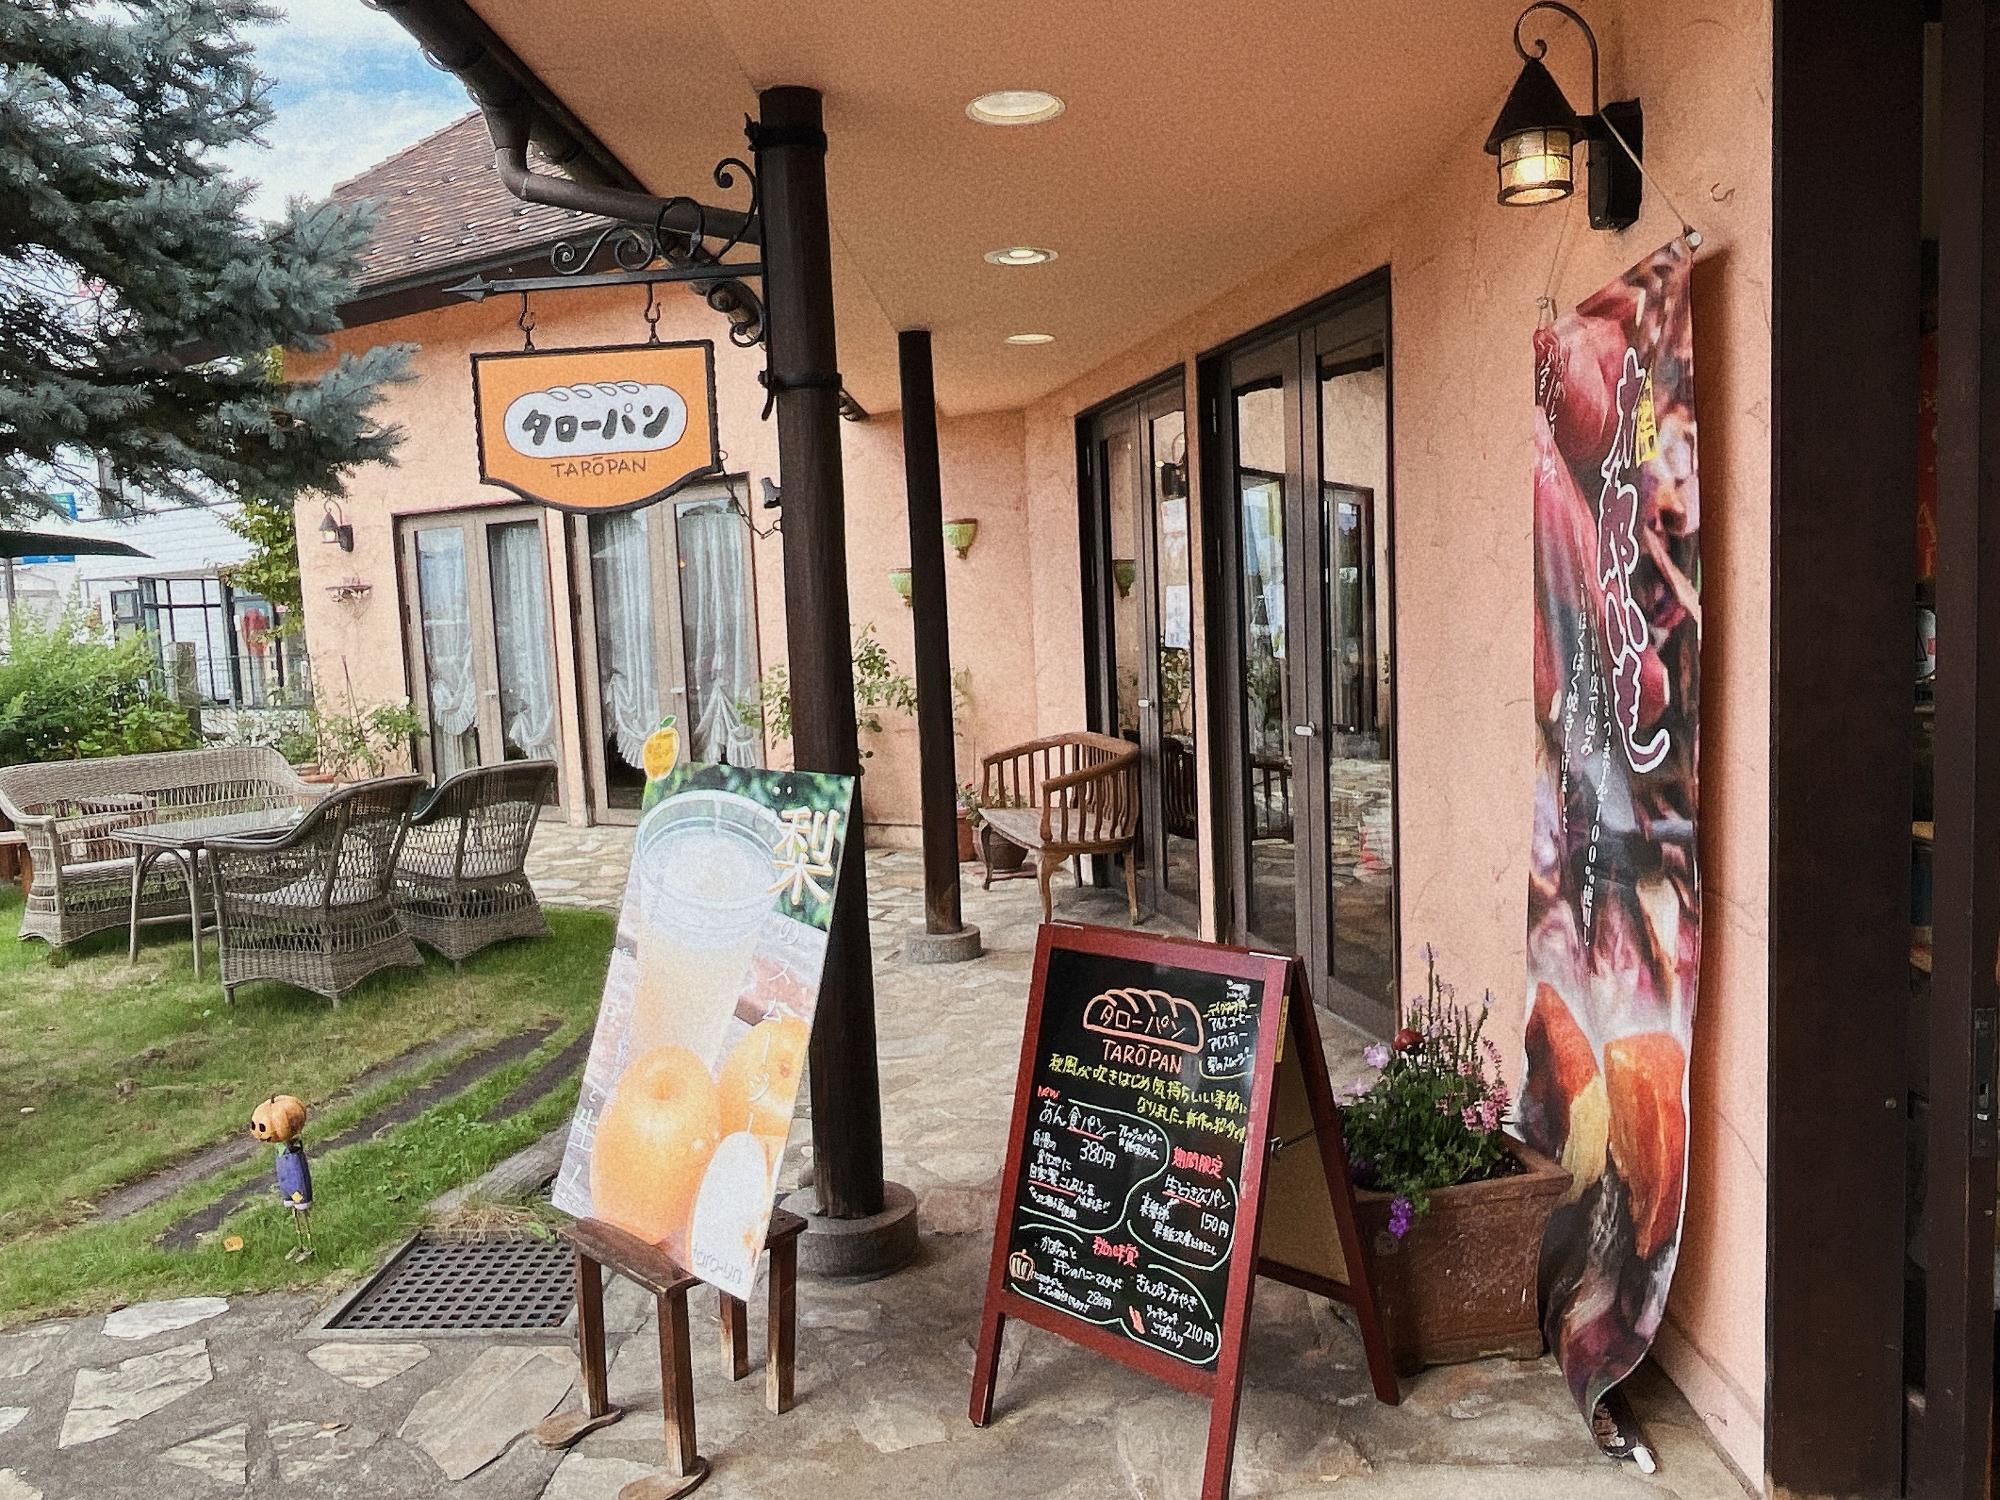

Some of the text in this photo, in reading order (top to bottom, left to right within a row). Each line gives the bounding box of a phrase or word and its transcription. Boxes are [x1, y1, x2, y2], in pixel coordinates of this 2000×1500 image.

[521, 402, 670, 446] タローパン
[1100, 1004, 1186, 1039] タローパン
[1207, 1032, 1249, 1052] アイスティー
[1039, 1099, 1106, 1135] あん食パン
[1080, 1138, 1117, 1169] 380円
[1172, 1146, 1223, 1179] 期間限定
[1200, 1212, 1230, 1238] 150円
[1183, 1321, 1215, 1348] 210円
